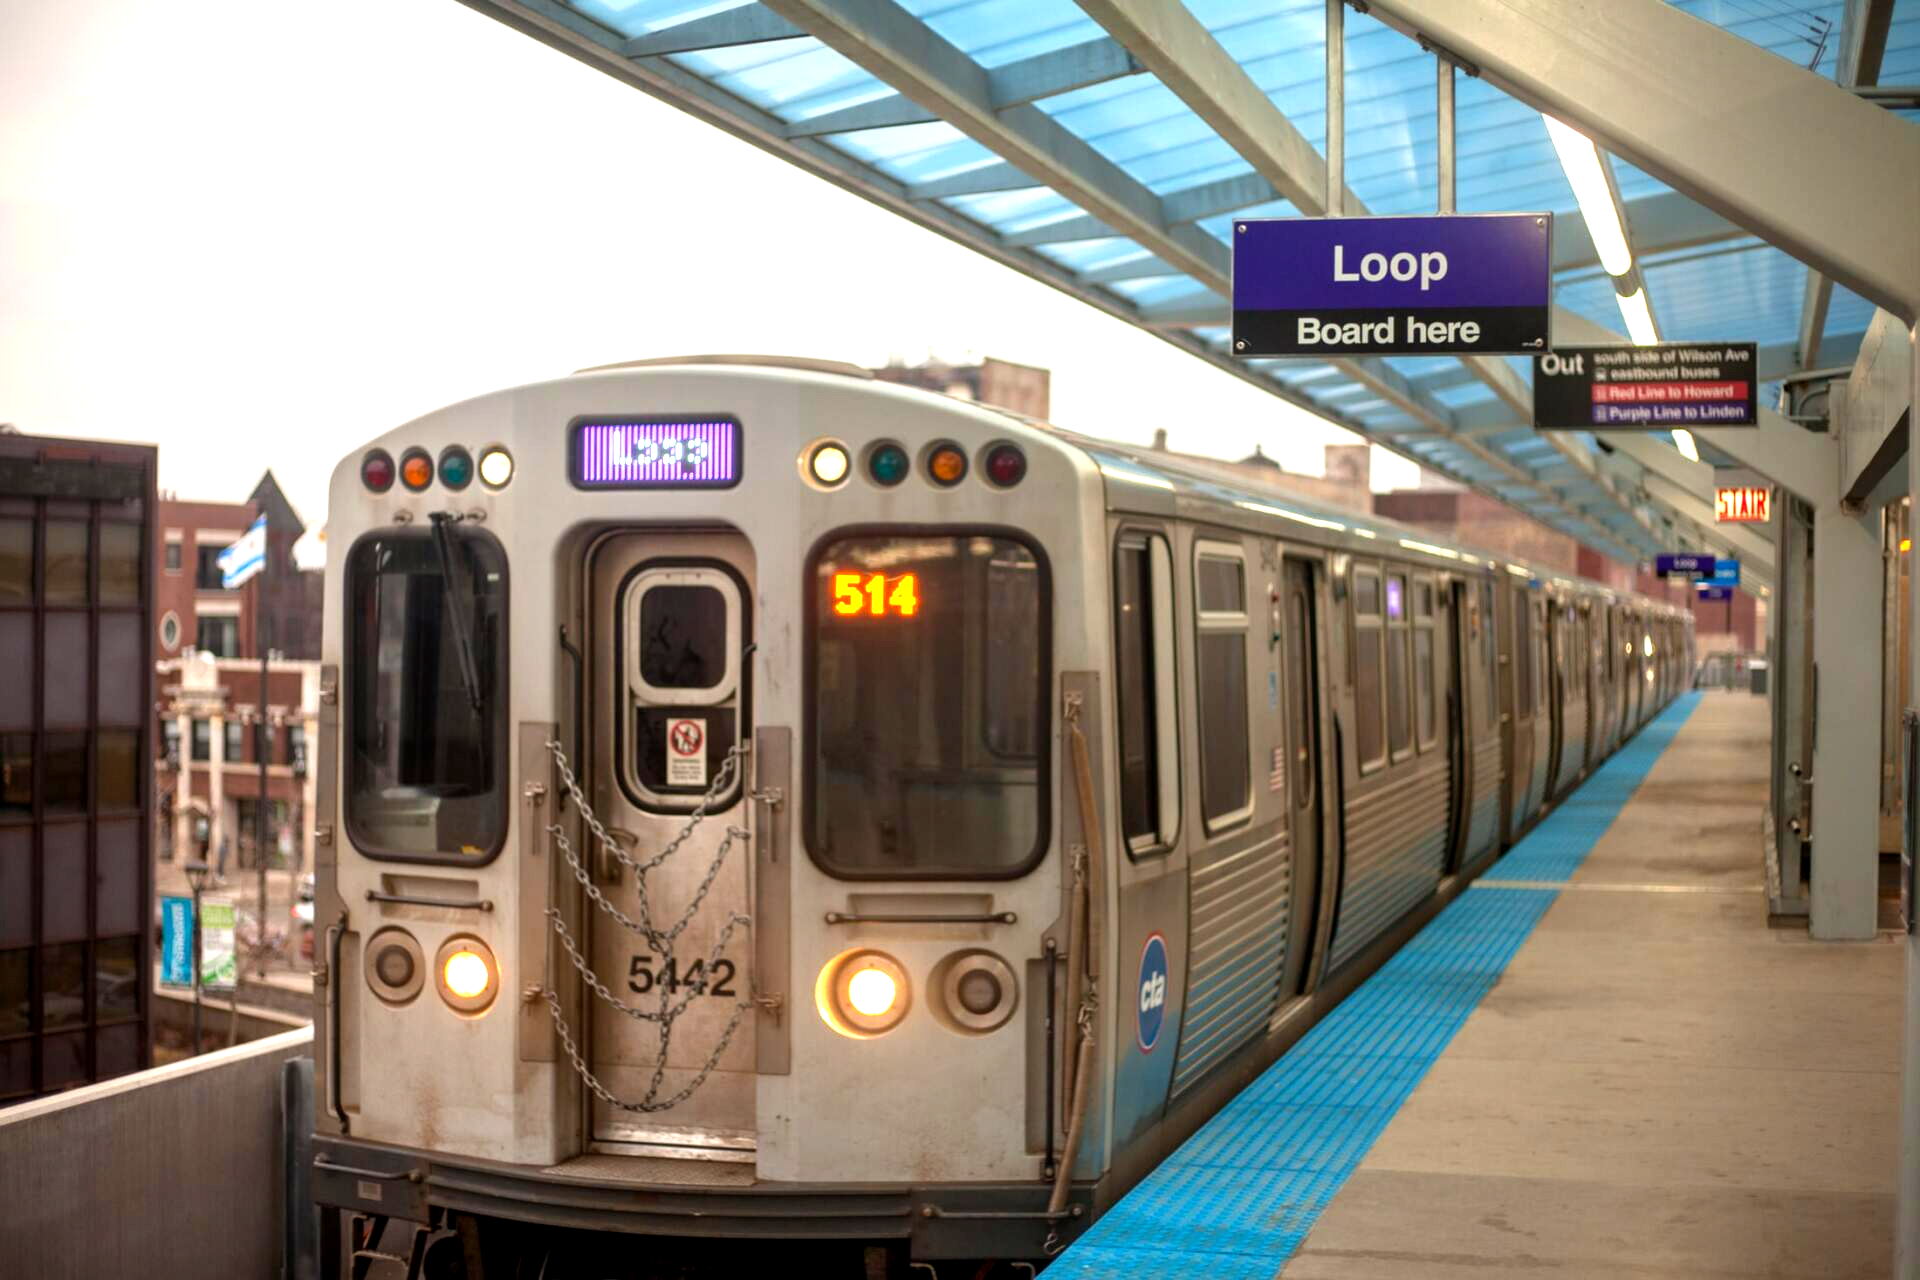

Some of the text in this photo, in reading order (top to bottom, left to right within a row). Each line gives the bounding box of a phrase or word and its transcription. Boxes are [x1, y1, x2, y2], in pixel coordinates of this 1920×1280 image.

[1333, 244, 1448, 291] Loop
[1297, 315, 1481, 345] Board here
[1540, 353, 1585, 376] Out
[1593, 348, 1750, 365] south side of Wilson Ave
[1610, 365, 1721, 380] eastbound buses
[1609, 384, 1734, 400] Red Line to Howard
[1609, 404, 1745, 422] Purple Line to Linden
[1718, 487, 1767, 518] STAIR
[835, 574, 917, 615] 514
[628, 955, 736, 997] 5442
